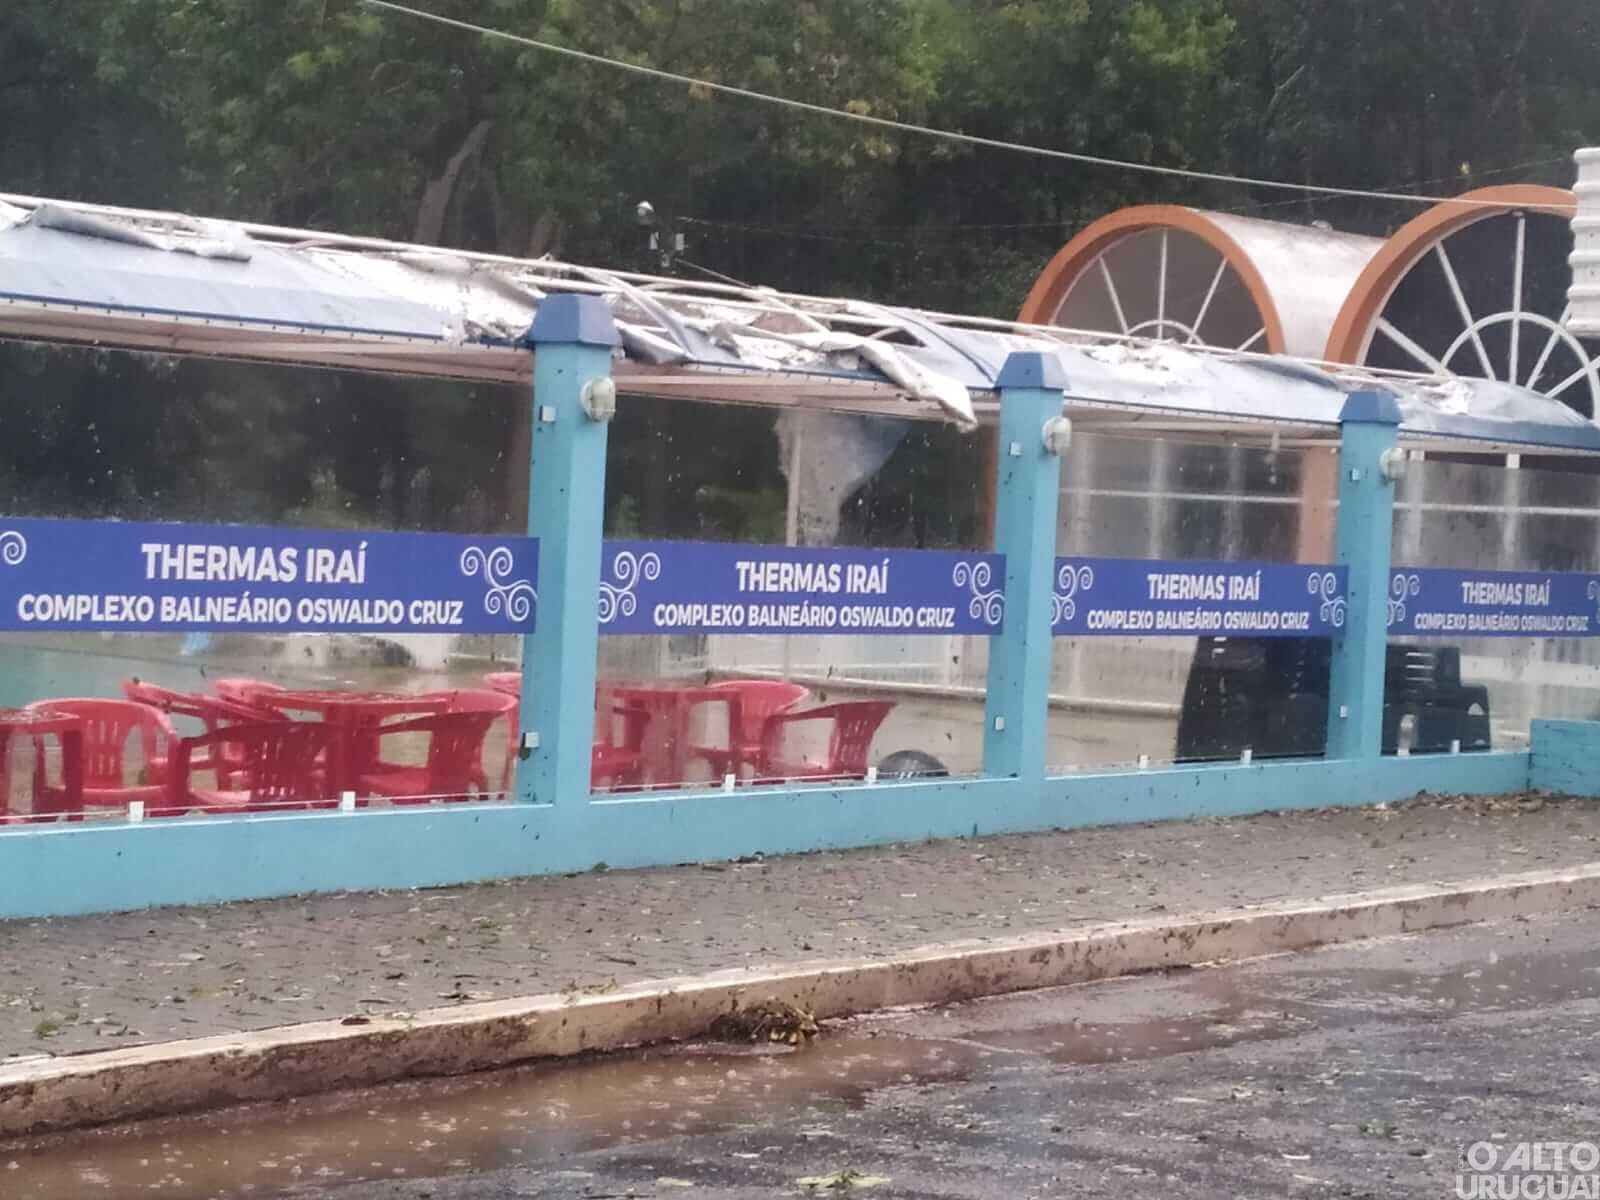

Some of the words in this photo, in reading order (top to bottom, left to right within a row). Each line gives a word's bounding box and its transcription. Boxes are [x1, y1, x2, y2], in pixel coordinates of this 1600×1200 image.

[141, 543, 298, 582] THERMAS
[305, 541, 368, 583] IRAÍ
[736, 561, 841, 593] THERMAS
[846, 558, 890, 594] IRAÍ
[1147, 573, 1225, 600] THERMAS
[1228, 570, 1261, 600] IRAÍ
[1461, 581, 1522, 605] THERMAS
[1525, 579, 1551, 606] IRAÍ
[18, 593, 154, 622] COMPLEXO
[160, 591, 291, 623] BALNEÁRIO
[297, 598, 404, 624] OSWALDO
[409, 600, 464, 625] CRUZ
[654, 603, 745, 627] COMPLEXO
[748, 600, 837, 627] BALNEÁRIO
[840, 606, 914, 627] OSWALDO
[916, 607, 955, 627] CRUZ
[1087, 609, 1153, 629] COMPLEXO
[1155, 607, 1221, 629] BALNEÁRIO
[1223, 611, 1279, 629] OSWALDO
[1280, 612, 1310, 629] CRUZ
[1414, 612, 1466, 630] COMPLEXO
[1468, 611, 1520, 631] BALNEÁRIO
[1521, 614, 1564, 631] OSWALDO
[1565, 615, 1589, 631] CRUZ
